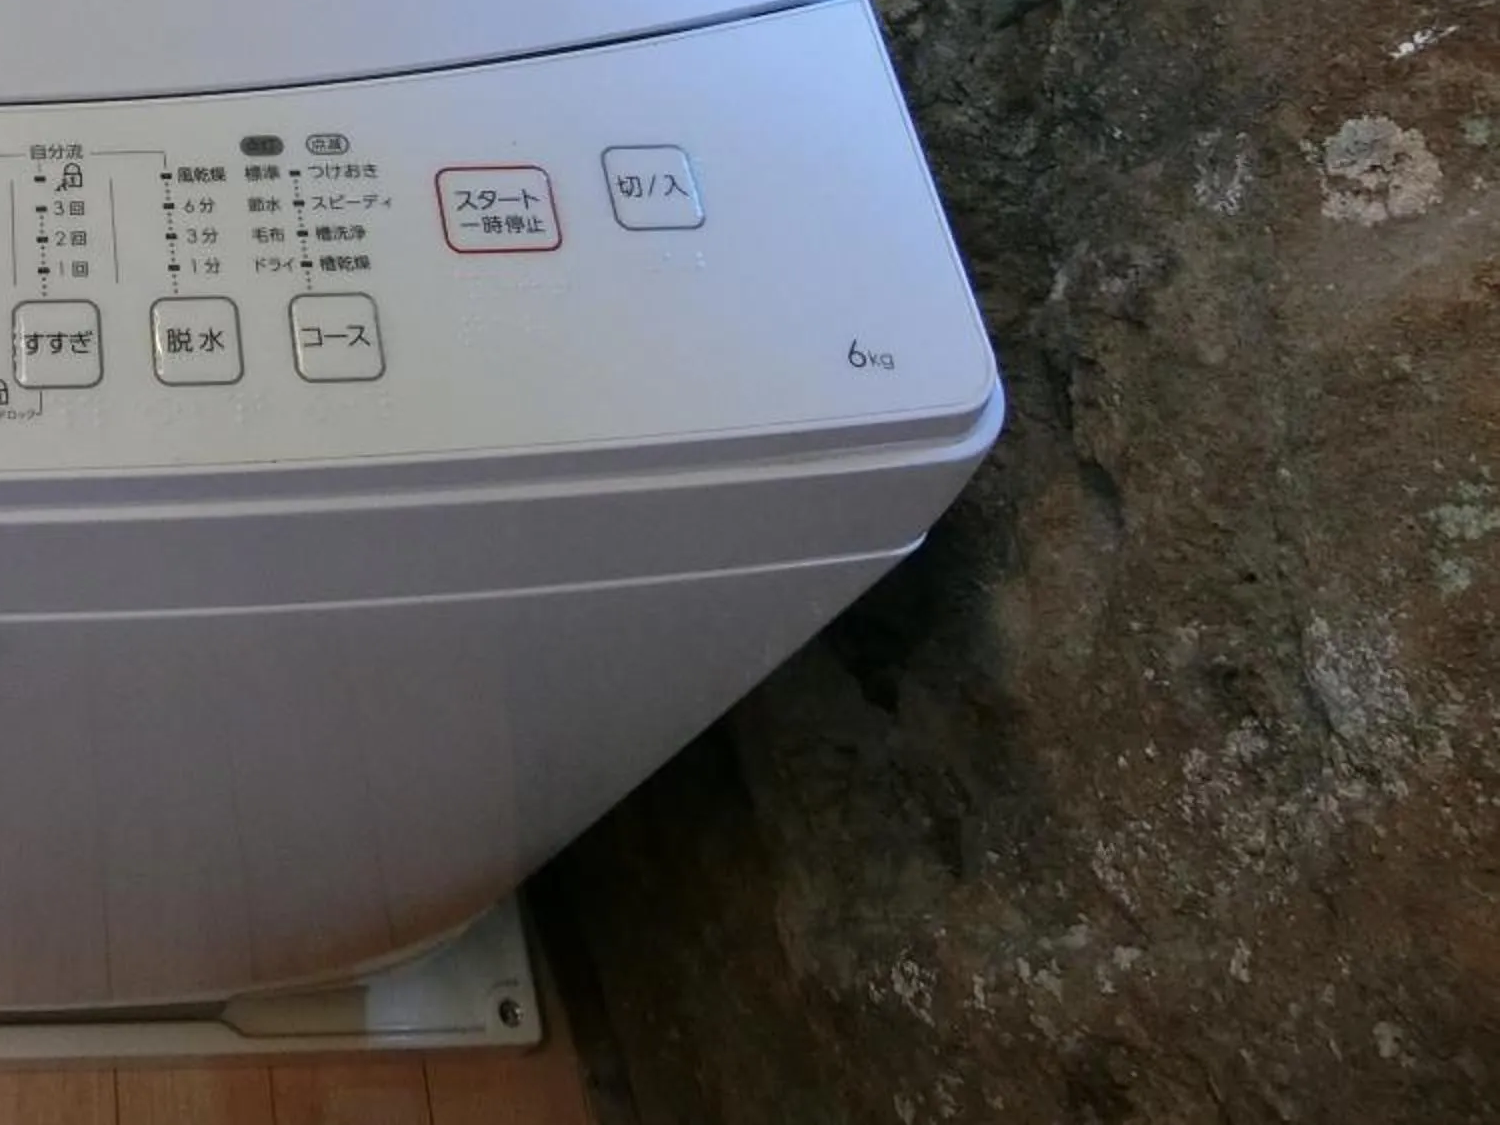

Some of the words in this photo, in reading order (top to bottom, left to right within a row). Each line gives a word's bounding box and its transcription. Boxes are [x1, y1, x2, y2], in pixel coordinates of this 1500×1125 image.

[30, 144, 83, 159] 自分流
[178, 167, 227, 183] 風乾燥
[245, 166, 281, 182] 標準
[308, 163, 378, 180] つけおき
[618, 174, 690, 198] 切/入
[184, 198, 216, 214] 6分
[248, 196, 281, 213] 節水
[311, 194, 392, 211] スピーディ
[455, 188, 541, 211] スタート
[54, 201, 86, 217] 3回
[315, 225, 367, 241] 槽洗浄
[460, 216, 546, 235] 一時停止
[55, 230, 88, 246] 2回
[186, 227, 219, 244] 3分
[252, 227, 285, 243] 毛布
[59, 260, 90, 278] 1回
[191, 257, 221, 274] 1分
[254, 257, 296, 273] ドライ
[319, 255, 371, 272] 槽乾燥
[23, 330, 94, 355] すすぎ
[167, 328, 225, 353] 脱水
[301, 325, 371, 348] コース
[848, 339, 895, 370] 6kg
